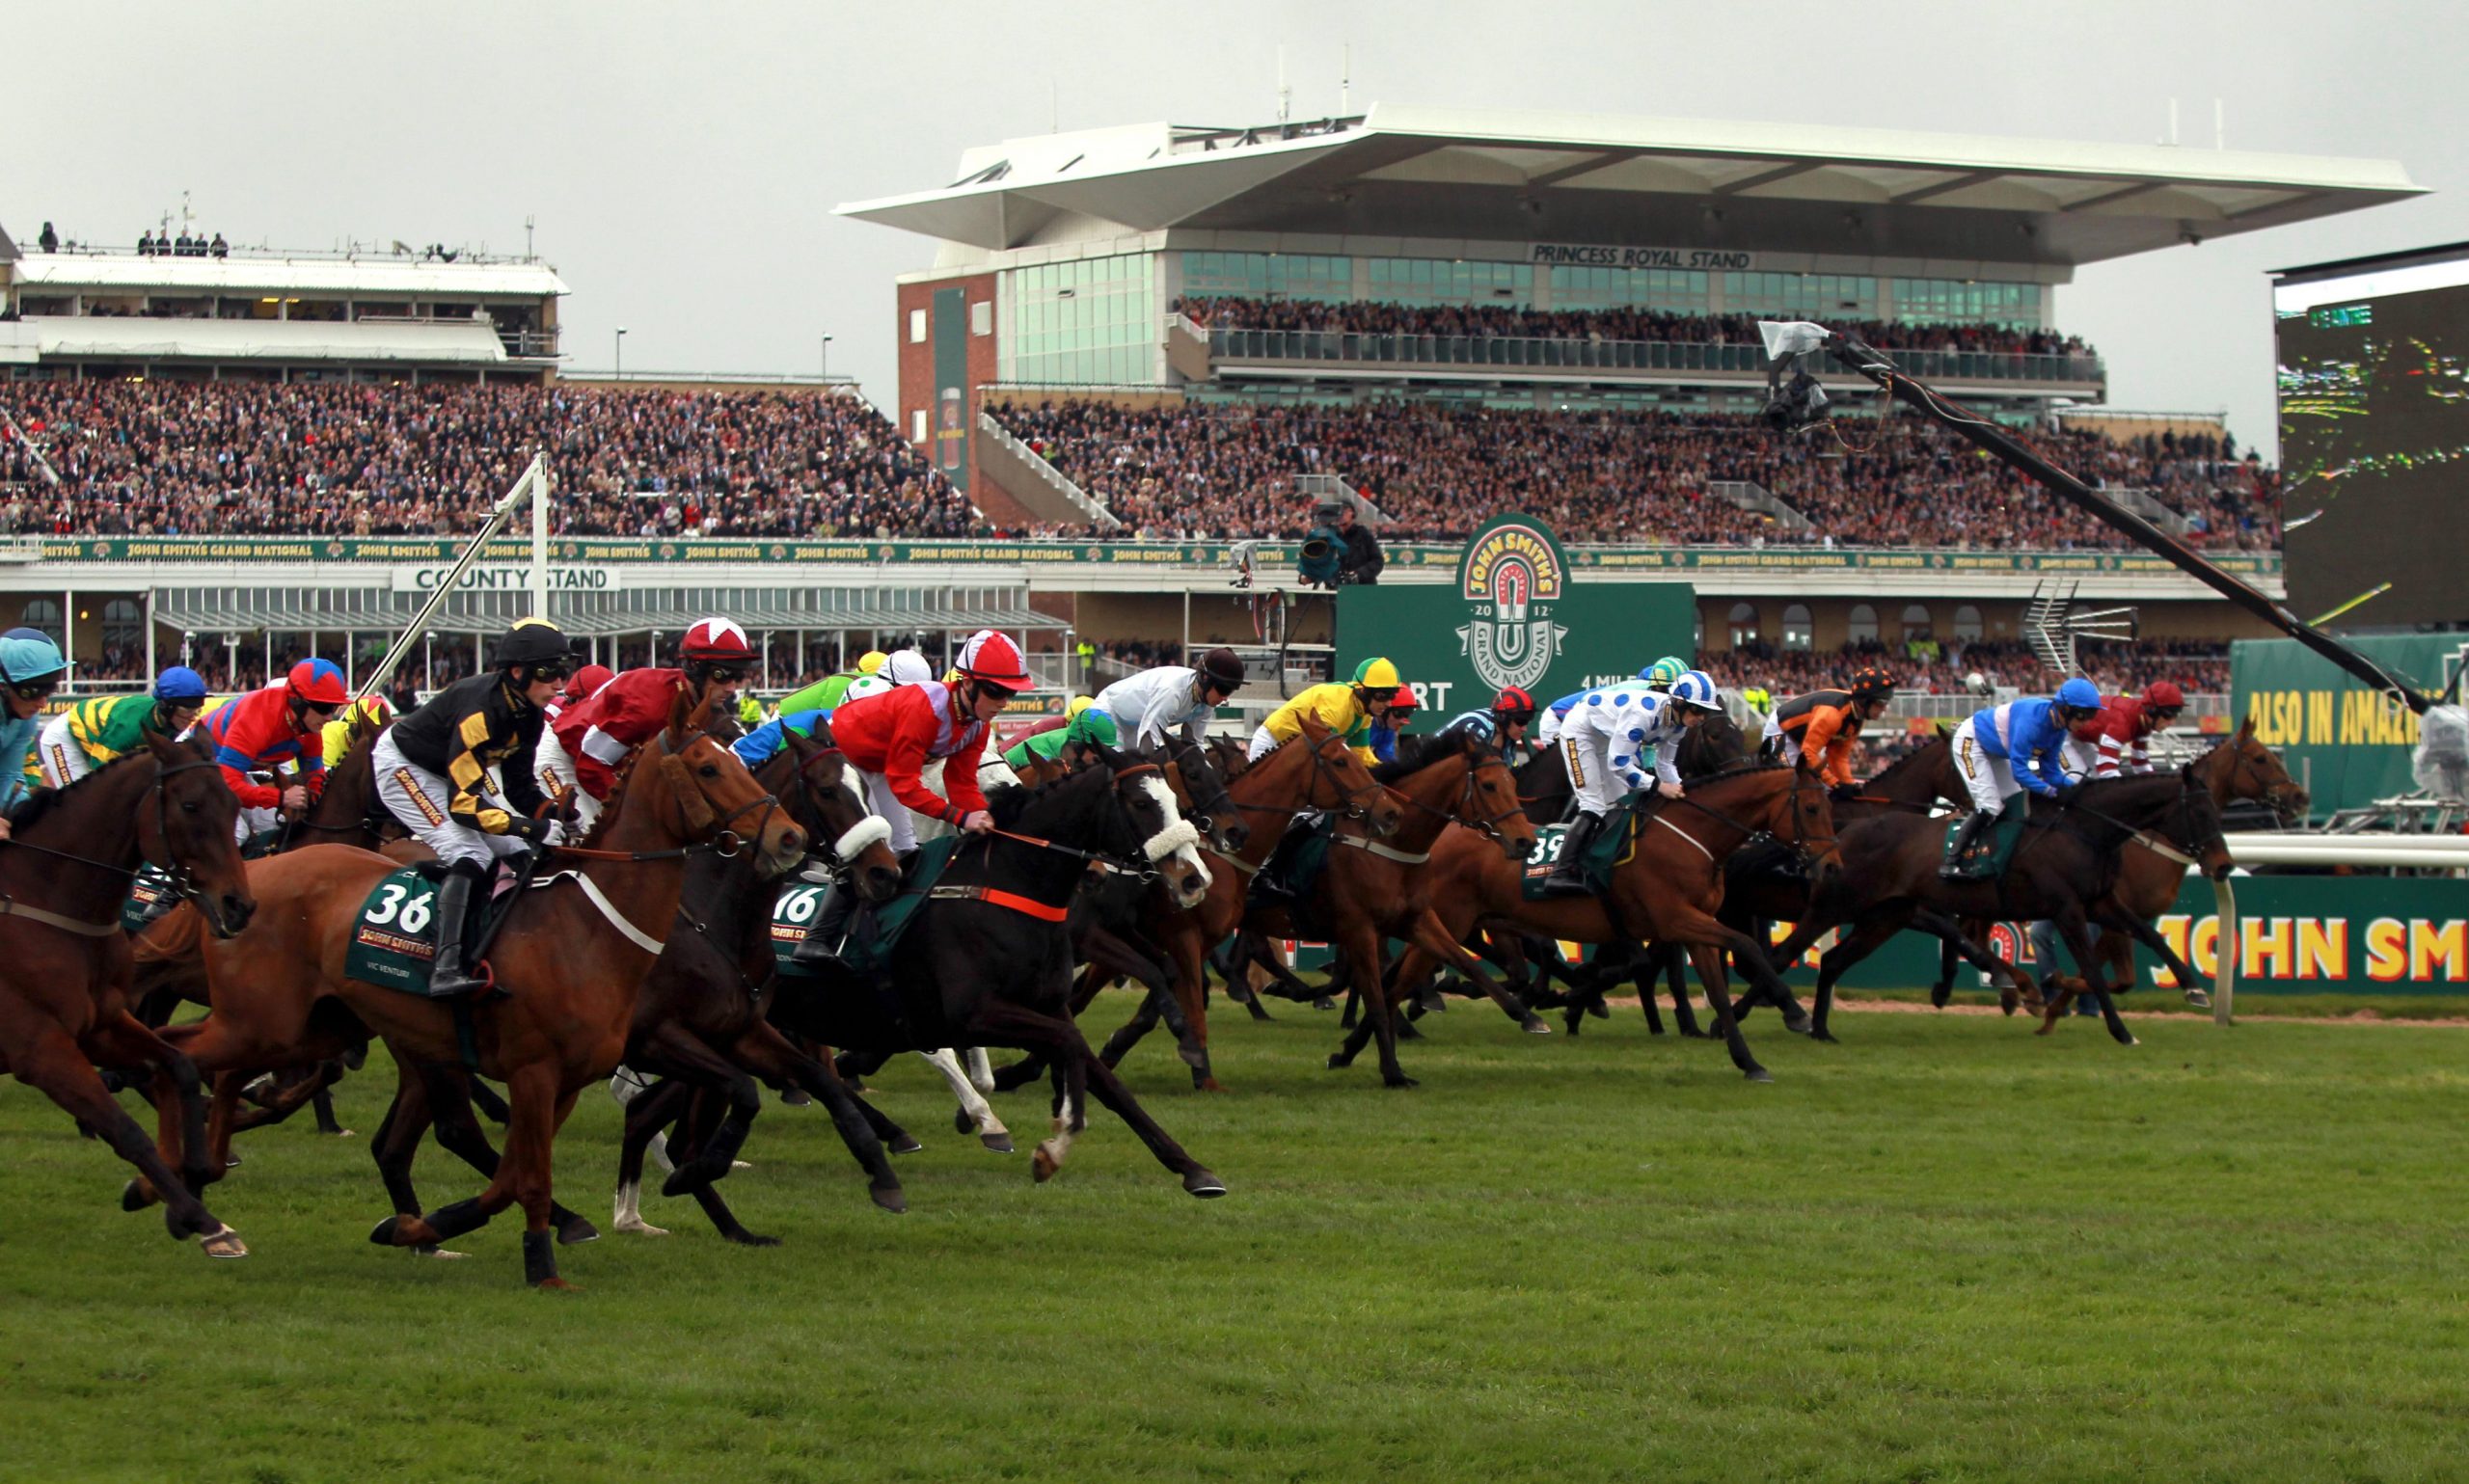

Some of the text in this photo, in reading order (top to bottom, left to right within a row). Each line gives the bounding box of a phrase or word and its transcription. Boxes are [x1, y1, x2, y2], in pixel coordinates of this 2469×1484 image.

[1533, 245, 1750, 269] PRINCESS ROYAL STAND
[42, 541, 81, 556] MITH'S
[127, 541, 313, 556] JOHN SMITH'S GRAND NATIONAL
[356, 542, 440, 557] JOHN SMITH'S
[483, 541, 559, 557] JOHN SMH'S
[585, 547, 610, 558] JOHN
[686, 547, 717, 559] JOHN
[795, 547, 826, 559] JOHN
[909, 547, 938, 559] JOHN
[983, 548, 1019, 559] GRAND
[1021, 549, 1074, 560] NATIONAL
[1113, 549, 1141, 561] JOHN
[1471, 532, 1560, 594] JOHN SMITH'S
[1476, 606, 1549, 616] 20 12
[1478, 627, 1546, 685] GRAND NATIONAL
[1582, 675, 1591, 691] 4
[2250, 690, 2302, 745] ALSO
[2309, 689, 2334, 744] IN
[396, 769, 418, 796] JOHN
[1527, 834, 1565, 865] 39
[365, 883, 435, 933] 36
[773, 887, 825, 923] 16
[360, 929, 390, 945] JOHN
[2150, 914, 2349, 988] JOHN
